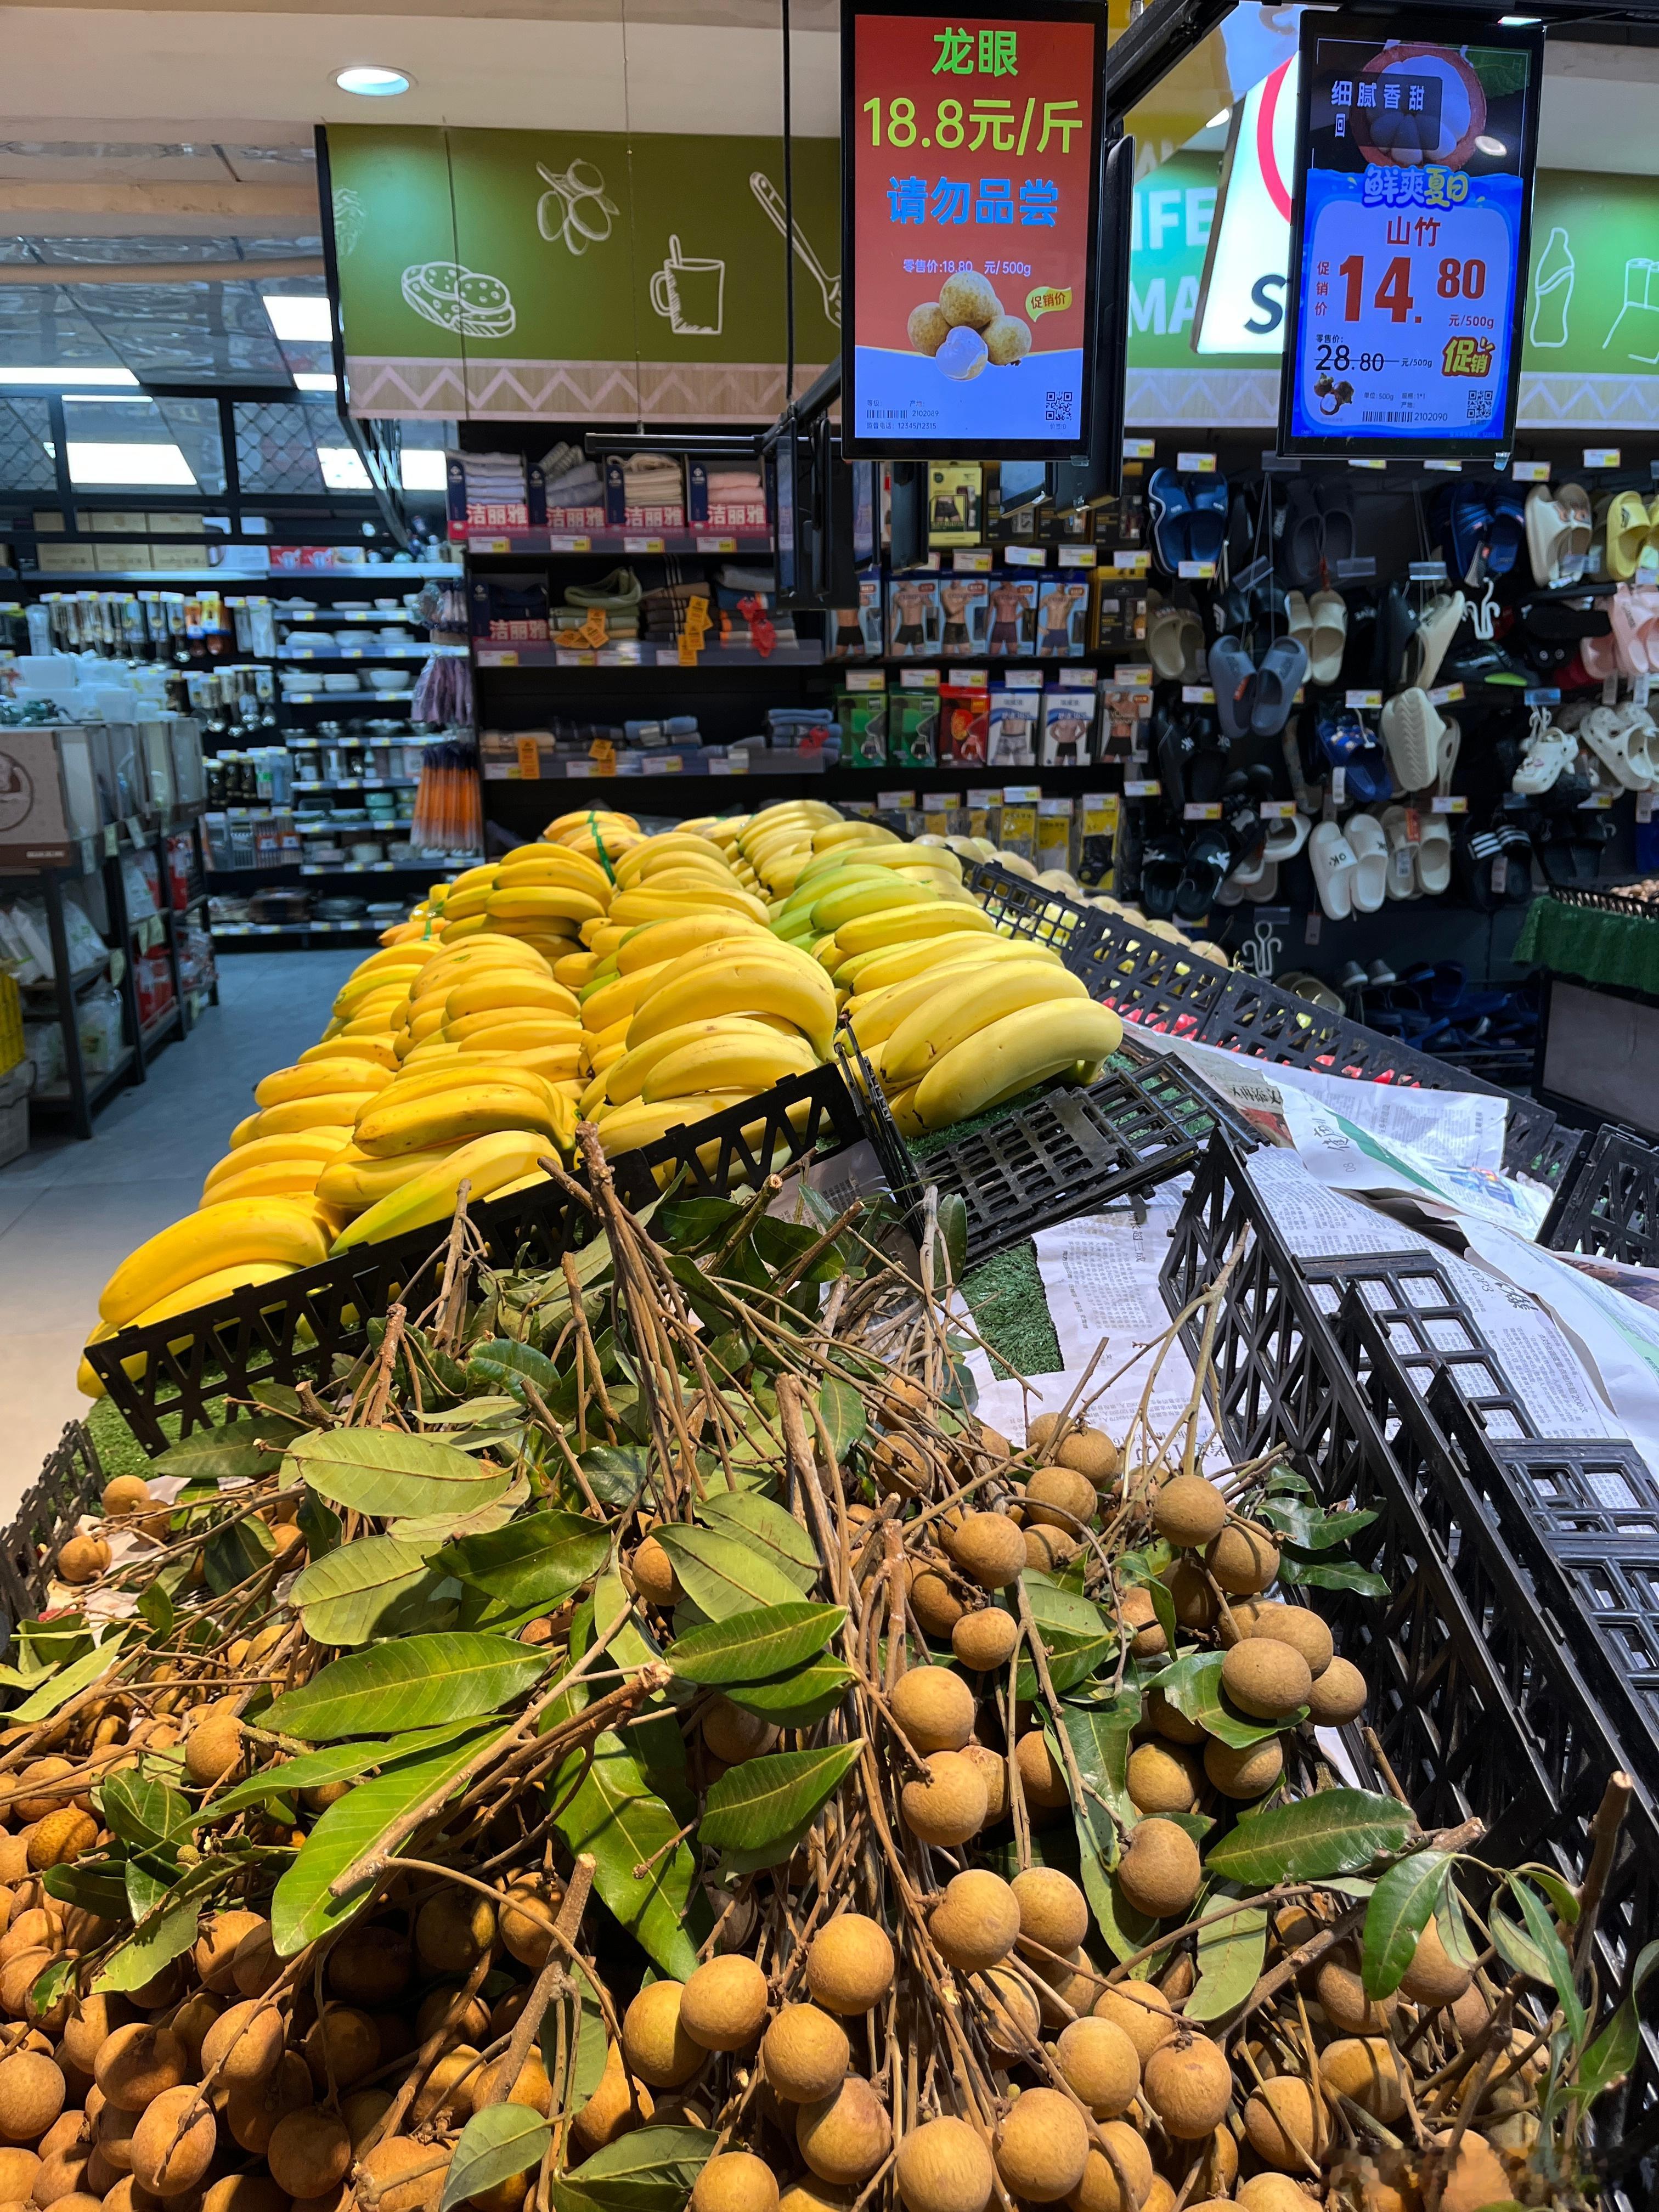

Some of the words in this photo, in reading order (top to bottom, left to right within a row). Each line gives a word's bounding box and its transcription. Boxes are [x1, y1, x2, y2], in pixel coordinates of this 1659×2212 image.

[932, 27, 1018, 77] 龙眼
[1331, 80, 1425, 111] 细腻香甜
[864, 97, 1082, 156] 18.8元/斤
[1364, 167, 1469, 207] 鲜爽夏日
[887, 176, 1058, 227] 请勿品尝
[1386, 216, 1441, 247] 山竹
[1030, 291, 1066, 309] 促销价
[1314, 261, 1330, 317] 促销价
[1448, 314, 1494, 329] 元/500g
[1443, 337, 1489, 375] 促销
[1414, 412, 1448, 421] 2102090
[466, 503, 528, 525] 洁丽雅
[546, 507, 605, 527] 洁丽雅
[625, 507, 684, 527] 洁丽雅
[708, 504, 766, 525] 洁丽雅
[490, 619, 548, 641] 洁丽雅
